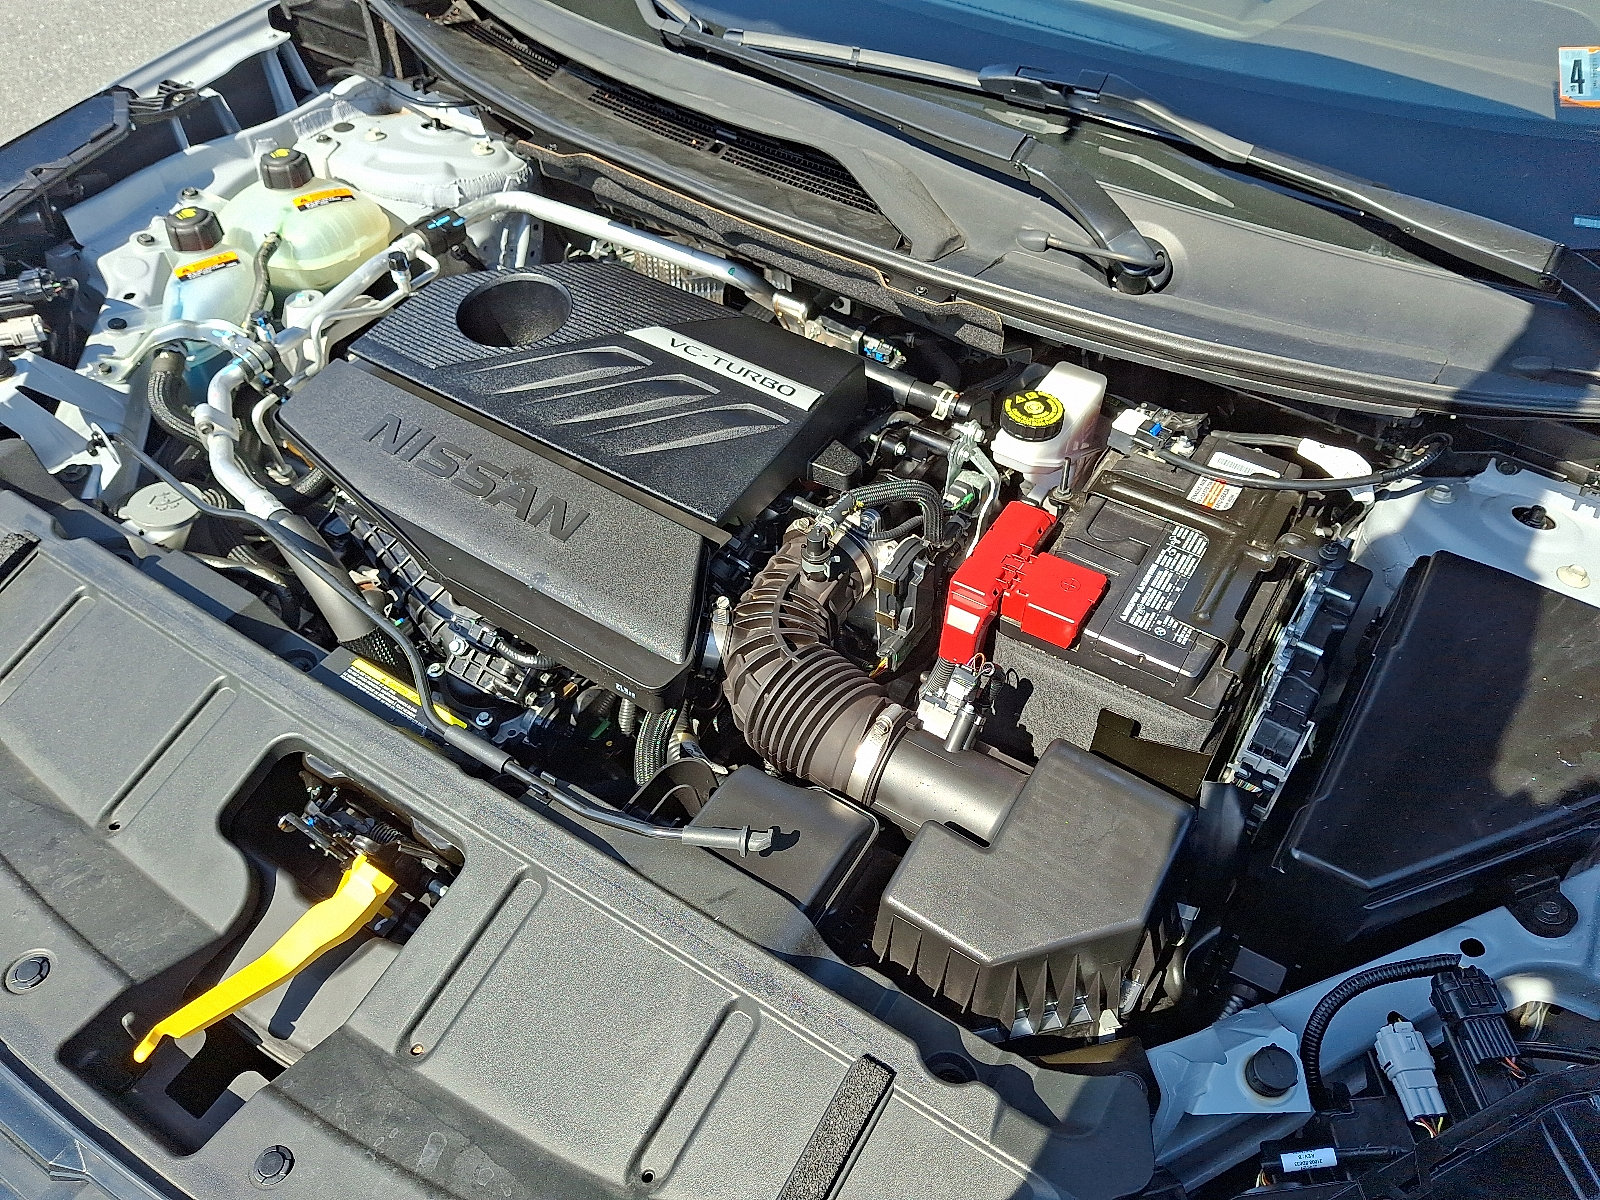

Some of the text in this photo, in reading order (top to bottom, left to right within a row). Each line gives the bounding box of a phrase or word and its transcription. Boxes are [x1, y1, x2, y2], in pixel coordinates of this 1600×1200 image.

[1570, 59, 1586, 95] 4
[669, 336, 796, 400] VC-TURBO
[361, 413, 591, 543] NISSAN
